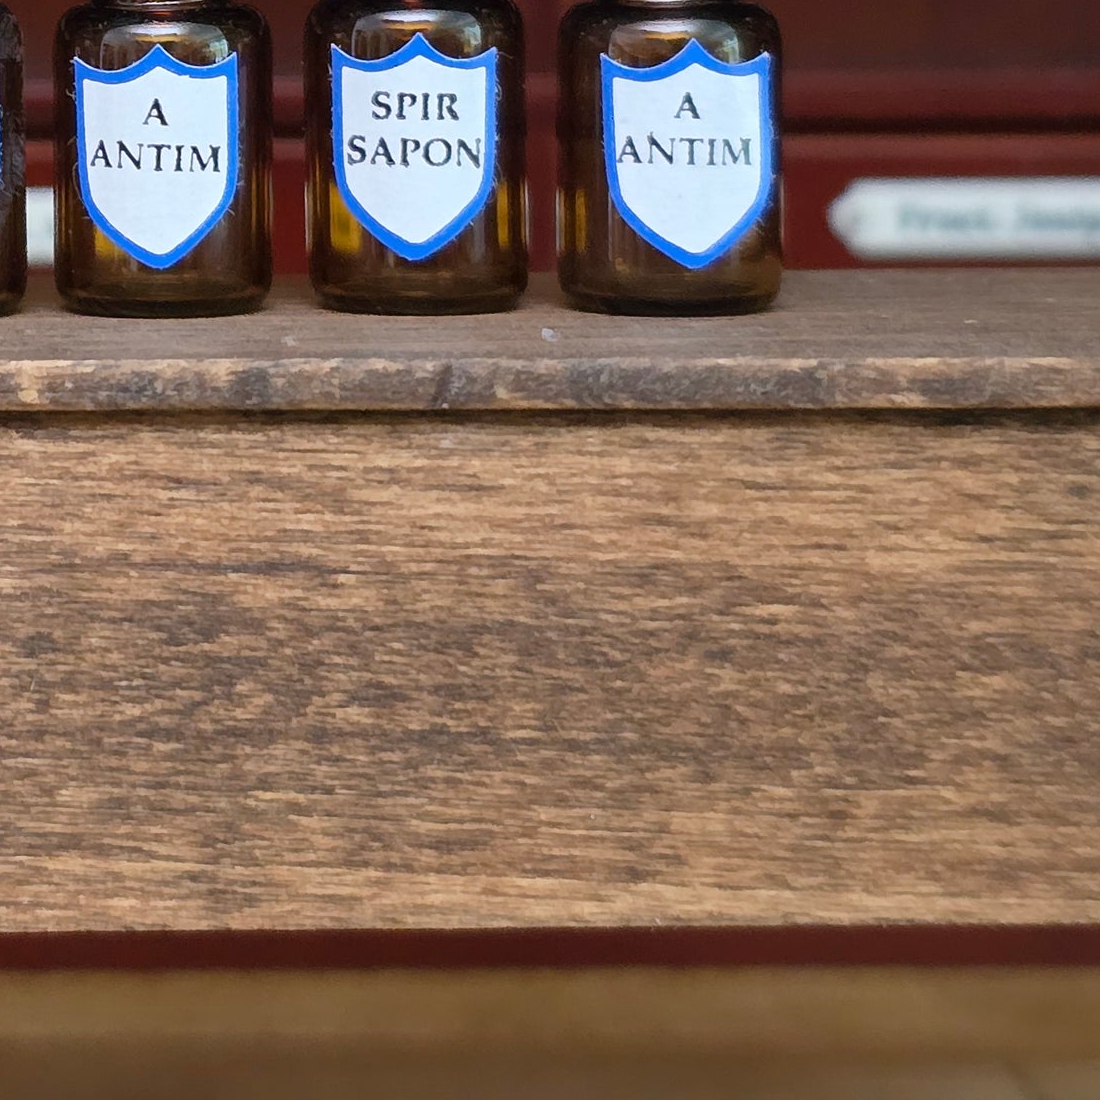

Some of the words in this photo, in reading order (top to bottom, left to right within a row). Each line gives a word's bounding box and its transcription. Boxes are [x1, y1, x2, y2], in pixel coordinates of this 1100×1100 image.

[143, 98, 169, 126] A
[370, 91, 460, 121] SPIR
[674, 92, 701, 119] A
[90, 140, 221, 173] ANTIM
[346, 134, 483, 169] SAPON
[616, 131, 753, 166] ANTIM
